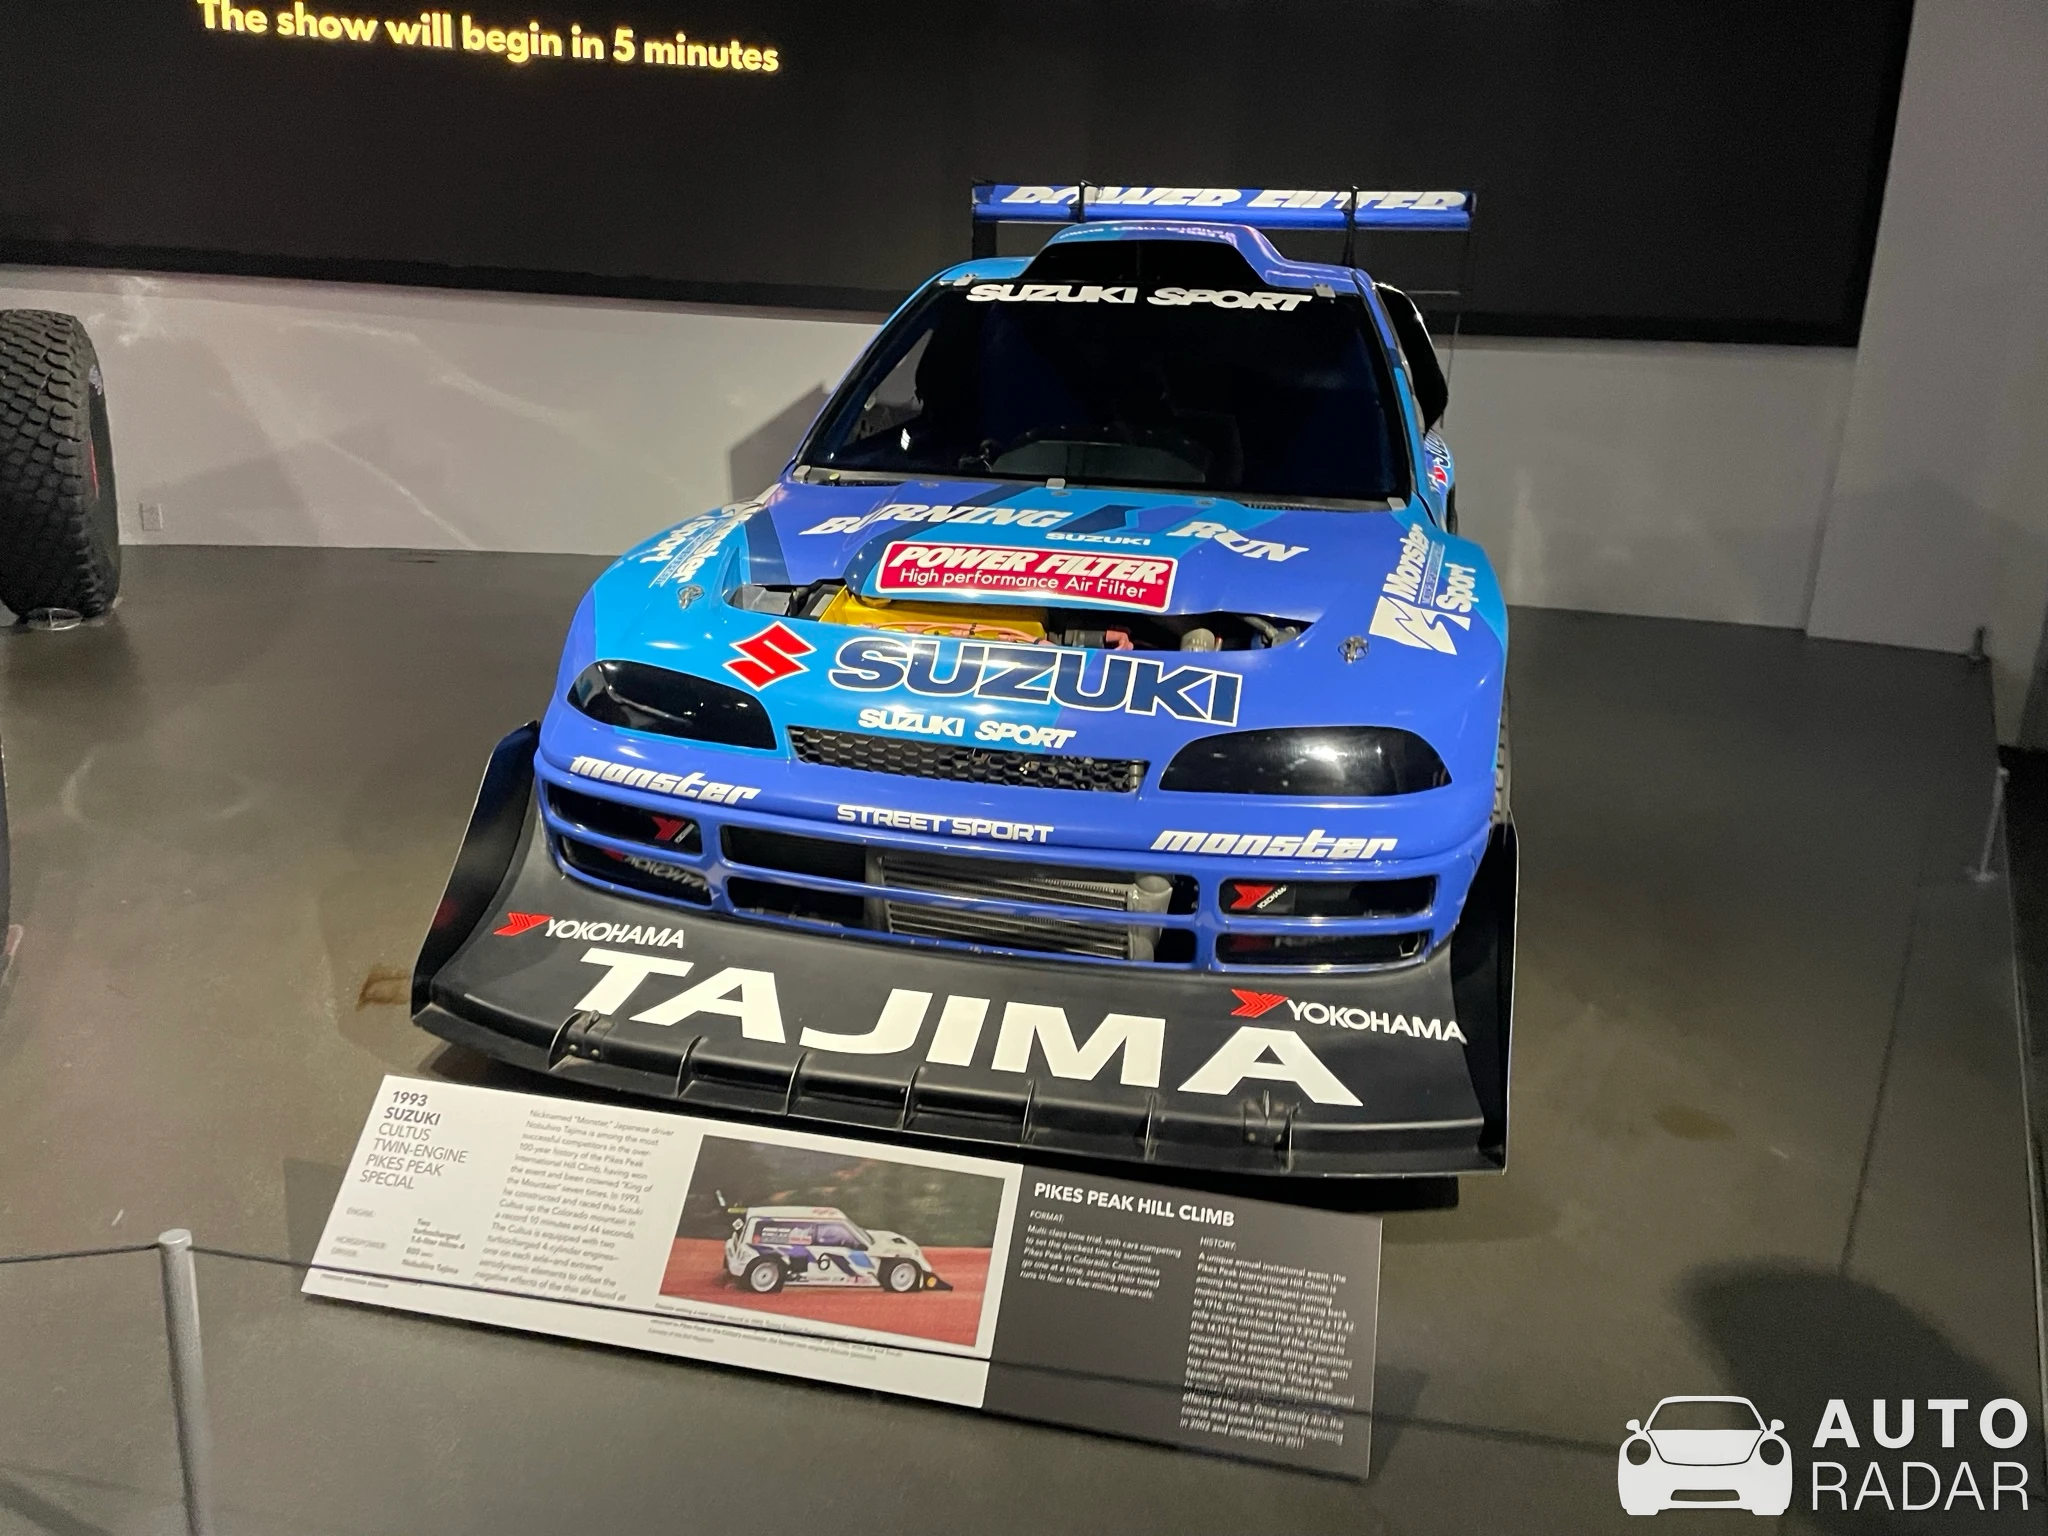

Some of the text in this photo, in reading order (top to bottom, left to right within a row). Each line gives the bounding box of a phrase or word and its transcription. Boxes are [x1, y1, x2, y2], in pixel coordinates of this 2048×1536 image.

[197, 0, 779, 72] The show will begin in 5 minutes
[966, 284, 1312, 312] SUZUKI SPORT
[799, 504, 1310, 562] BURNING RUN
[1045, 532, 1151, 547] SUZUKI
[889, 546, 1038, 573] POWER
[1383, 523, 1430, 601] Monster
[899, 565, 1147, 600] High performance Air Filter
[1436, 562, 1479, 612] Sport
[828, 637, 1242, 727] SUZUKI
[858, 708, 1077, 749] SUZUKI SPORT
[570, 756, 762, 805] monster
[837, 804, 1054, 843] STREET SPORT
[1151, 829, 1397, 860] monster
[543, 917, 687, 950] YOKOHAMA
[575, 948, 1363, 1106] TAJIMA
[1286, 1001, 1466, 1044] YOKOHAMA
[389, 1090, 429, 1107] 1993
[377, 1122, 432, 1141] CULTUS
[383, 1106, 441, 1126] SUZUKI
[365, 1153, 445, 1176] PIKES PEAK
[371, 1137, 468, 1163] TWIN-ENGINE
[358, 1168, 417, 1189] SPECIAL
[1033, 1182, 1235, 1227] PIKES PEAK HILL CLIMB
[817, 1252, 830, 1270] 6
